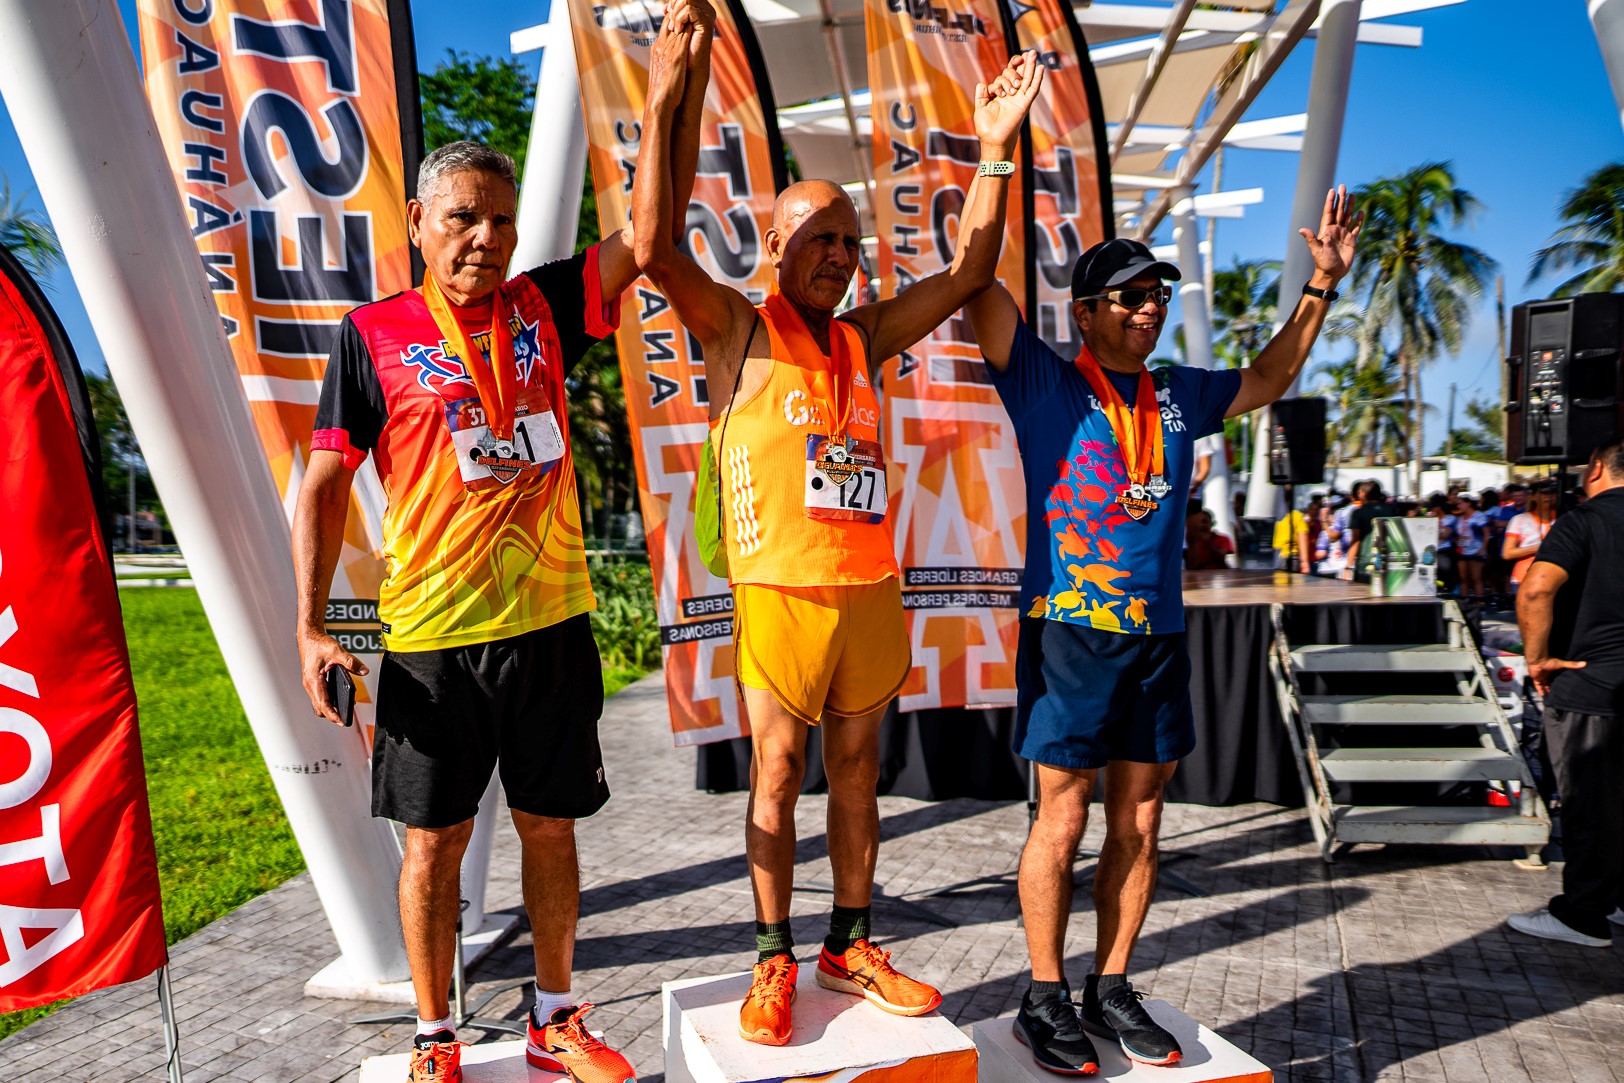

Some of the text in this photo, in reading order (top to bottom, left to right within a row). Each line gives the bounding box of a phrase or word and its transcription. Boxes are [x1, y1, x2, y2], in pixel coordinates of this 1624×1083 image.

[783, 389, 876, 428] Galas
[477, 455, 532, 470] DELFINES
[840, 470, 876, 510] 127
[1116, 496, 1158, 510] DELFINES
[0, 548, 85, 987] YOTA
